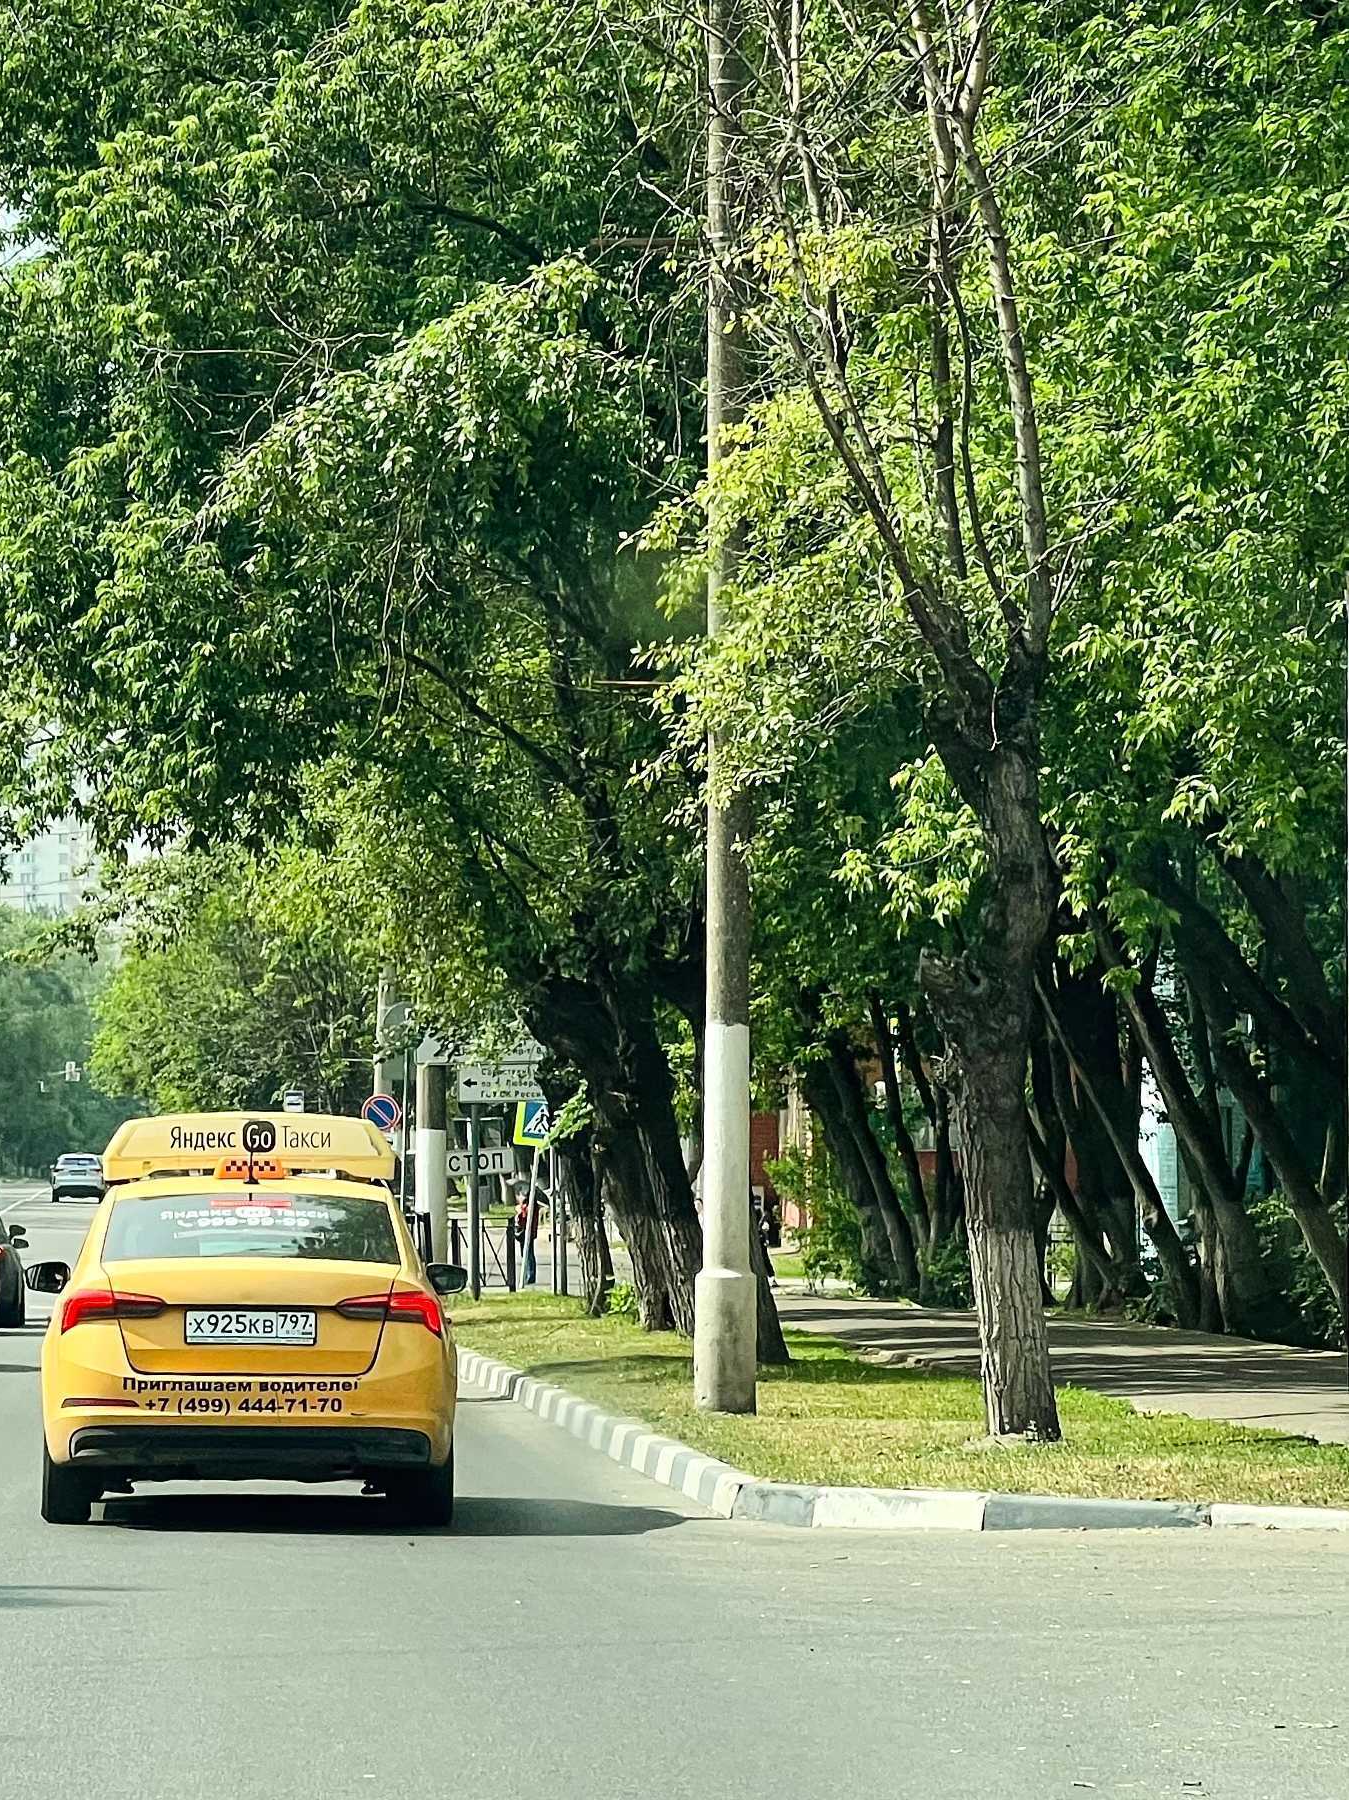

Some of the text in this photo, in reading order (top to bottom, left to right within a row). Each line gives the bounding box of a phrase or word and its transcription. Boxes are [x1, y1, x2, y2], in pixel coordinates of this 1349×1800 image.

[170, 1124, 331, 1151] Яндекс Go Такси
[448, 1153, 504, 1172] СТОП
[192, 1313, 310, 1334] Х925КВ 797
[122, 1377, 252, 1393] Приглашаем
[145, 1397, 343, 1416] +7 (499) 444-71-70
